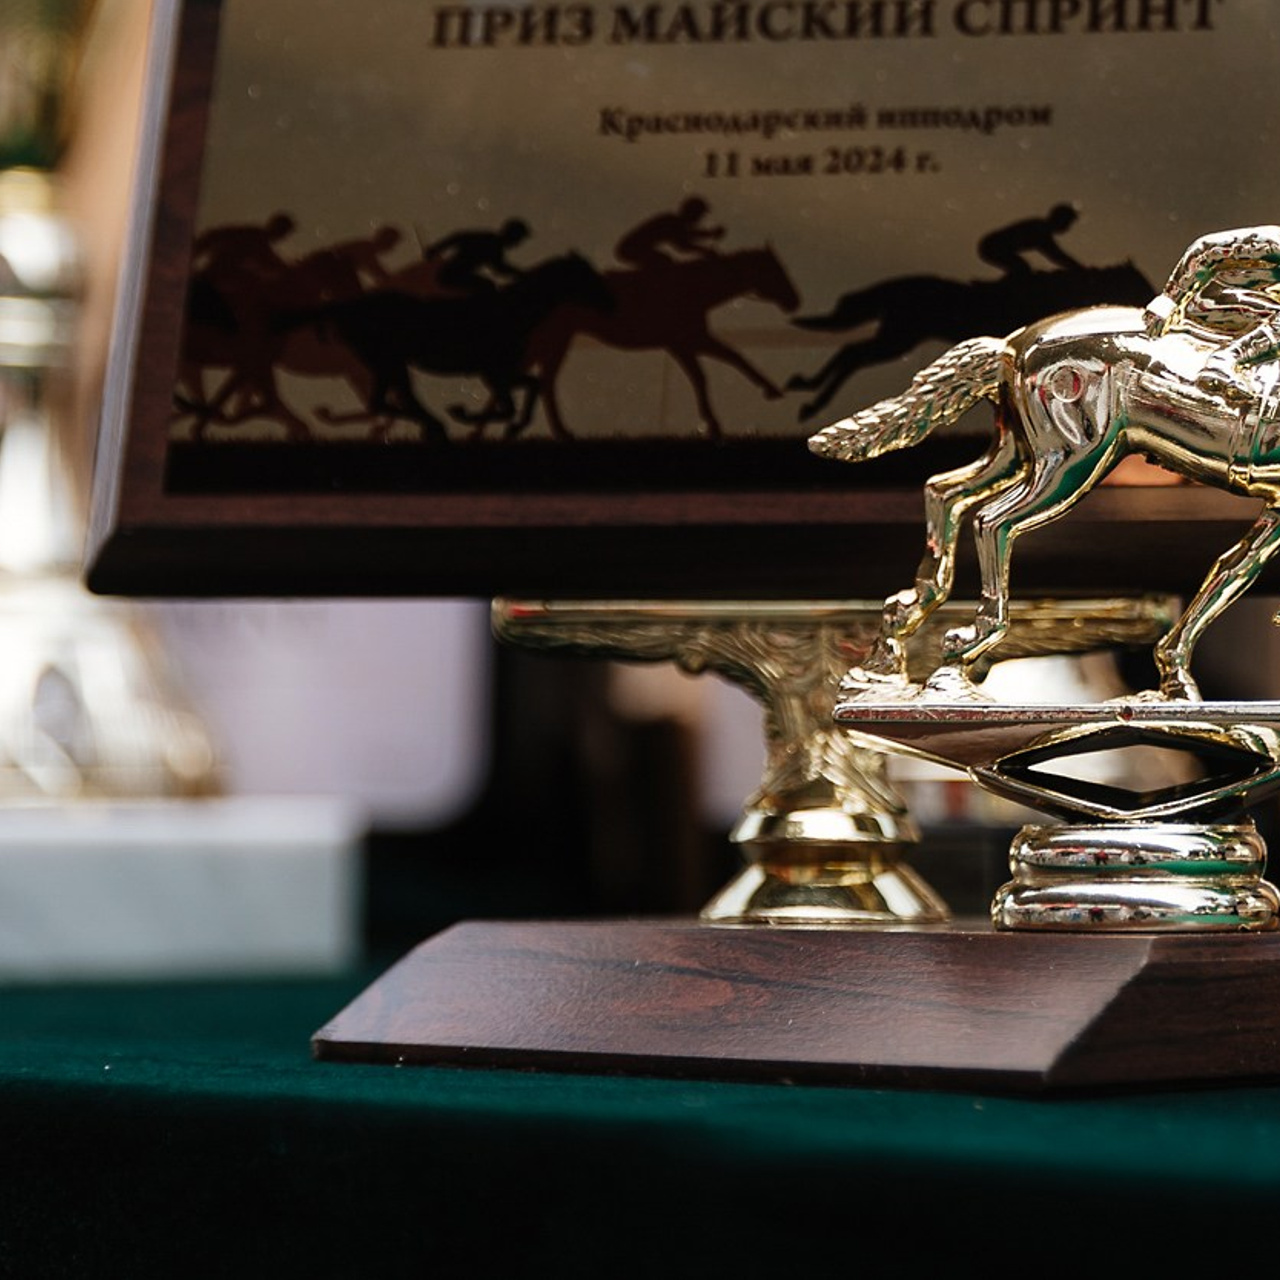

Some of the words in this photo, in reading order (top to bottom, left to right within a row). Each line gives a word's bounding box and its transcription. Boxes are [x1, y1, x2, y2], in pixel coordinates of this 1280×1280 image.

[431, 4, 595, 48] ПРИЗ
[599, 103, 868, 144] Краснодарский
[876, 104, 1053, 137] ипподром
[704, 150, 741, 179] 11
[750, 155, 815, 177] мая
[822, 145, 907, 175] 2024
[914, 151, 941, 174] г.
